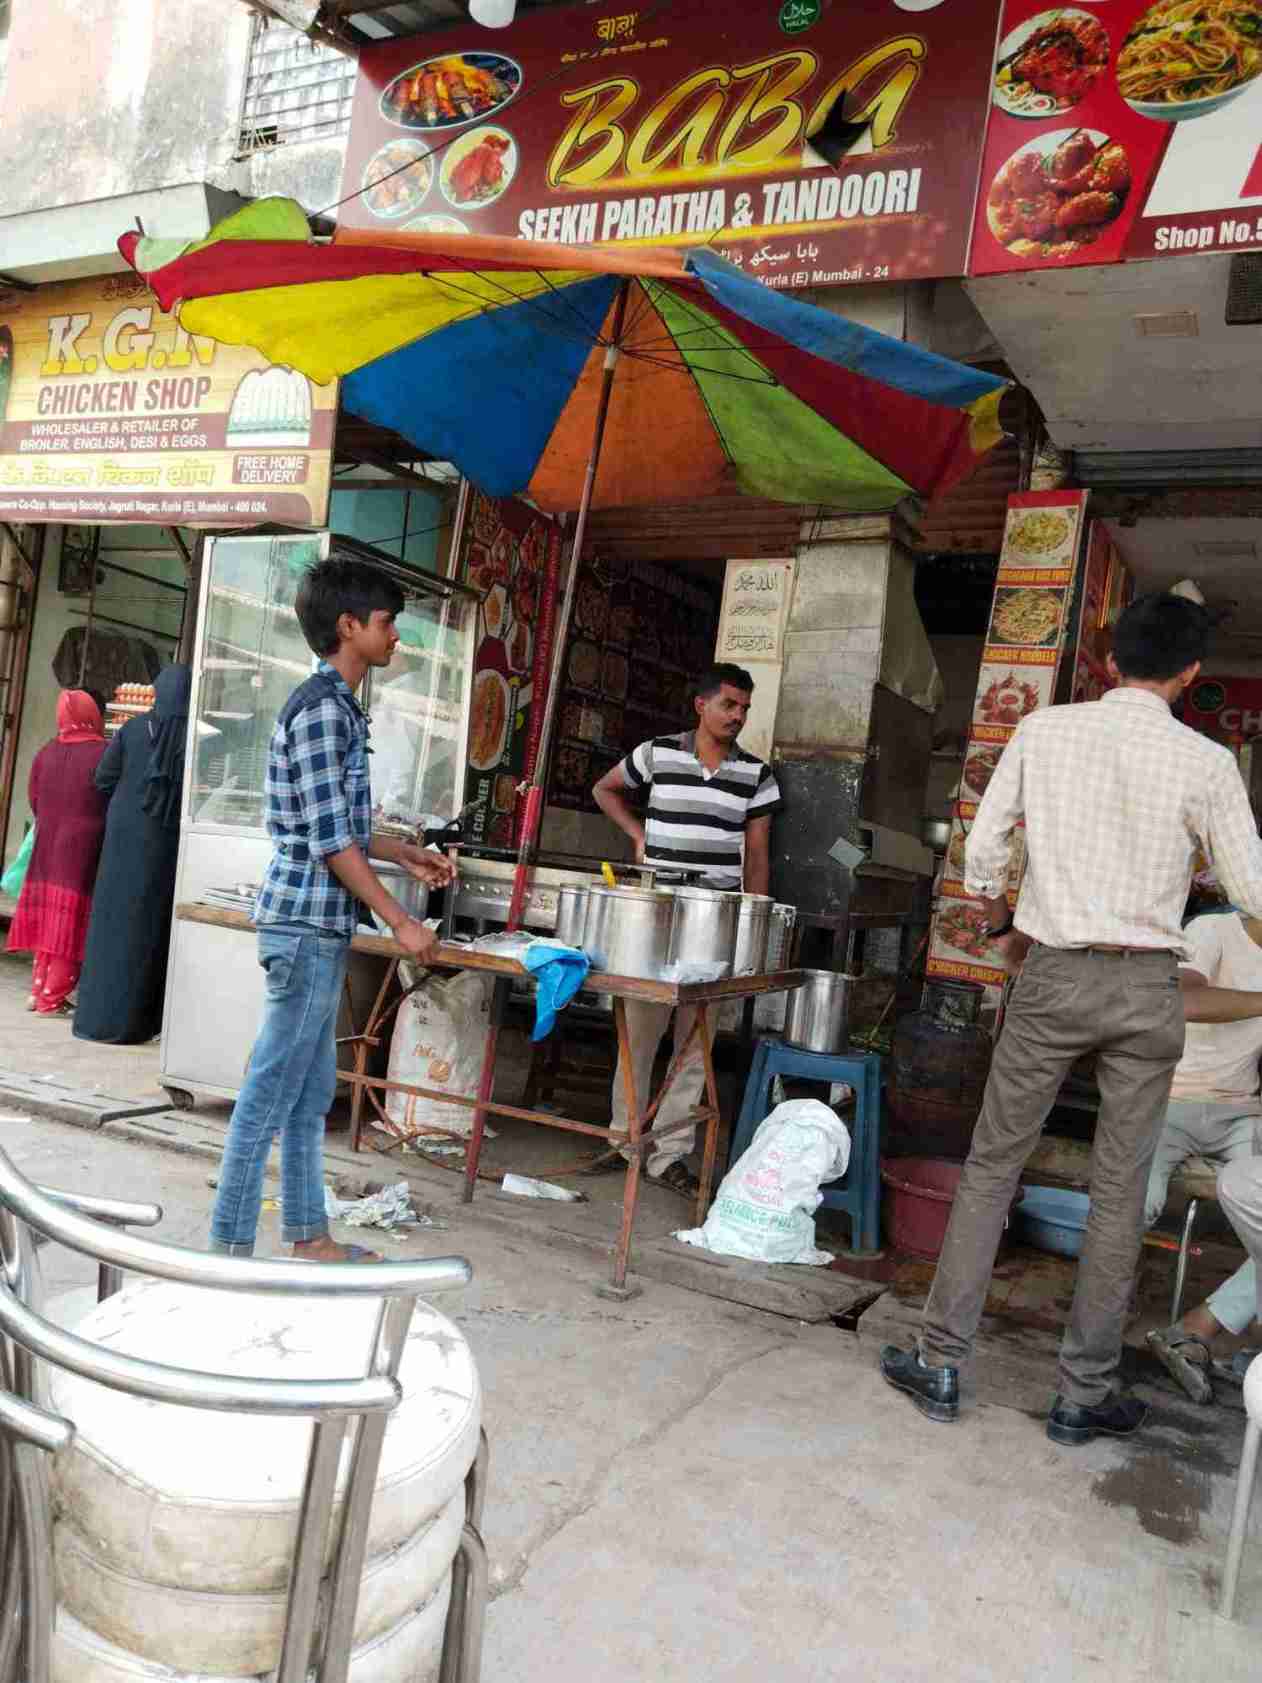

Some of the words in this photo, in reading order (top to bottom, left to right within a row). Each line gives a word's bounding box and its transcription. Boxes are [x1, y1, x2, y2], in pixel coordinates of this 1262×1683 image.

[517, 203, 597, 244] SEEKH
[601, 189, 727, 240] PARATHA
[730, 192, 754, 228] &
[761, 168, 922, 225] TANDOORI
[1154, 225, 1215, 251] Shop
[791, 271, 809, 288] (E)
[812, 264, 862, 284] Mumbai
[873, 265, 889, 279] 24
[37, 380, 137, 416] CHICKEN
[145, 376, 212, 411] SHOP
[32, 422, 109, 436] WHOLESALER
[110, 421, 119, 433] &
[121, 419, 178, 433] RETAILER
[180, 418, 200, 431] OF
[73, 436, 128, 452] ENGLISH,
[131, 436, 157, 449] DESI
[160, 435, 168, 448] &
[238, 456, 266, 470] FREE
[270, 456, 305, 470] HOME
[240, 470, 297, 483] DELIVERY
